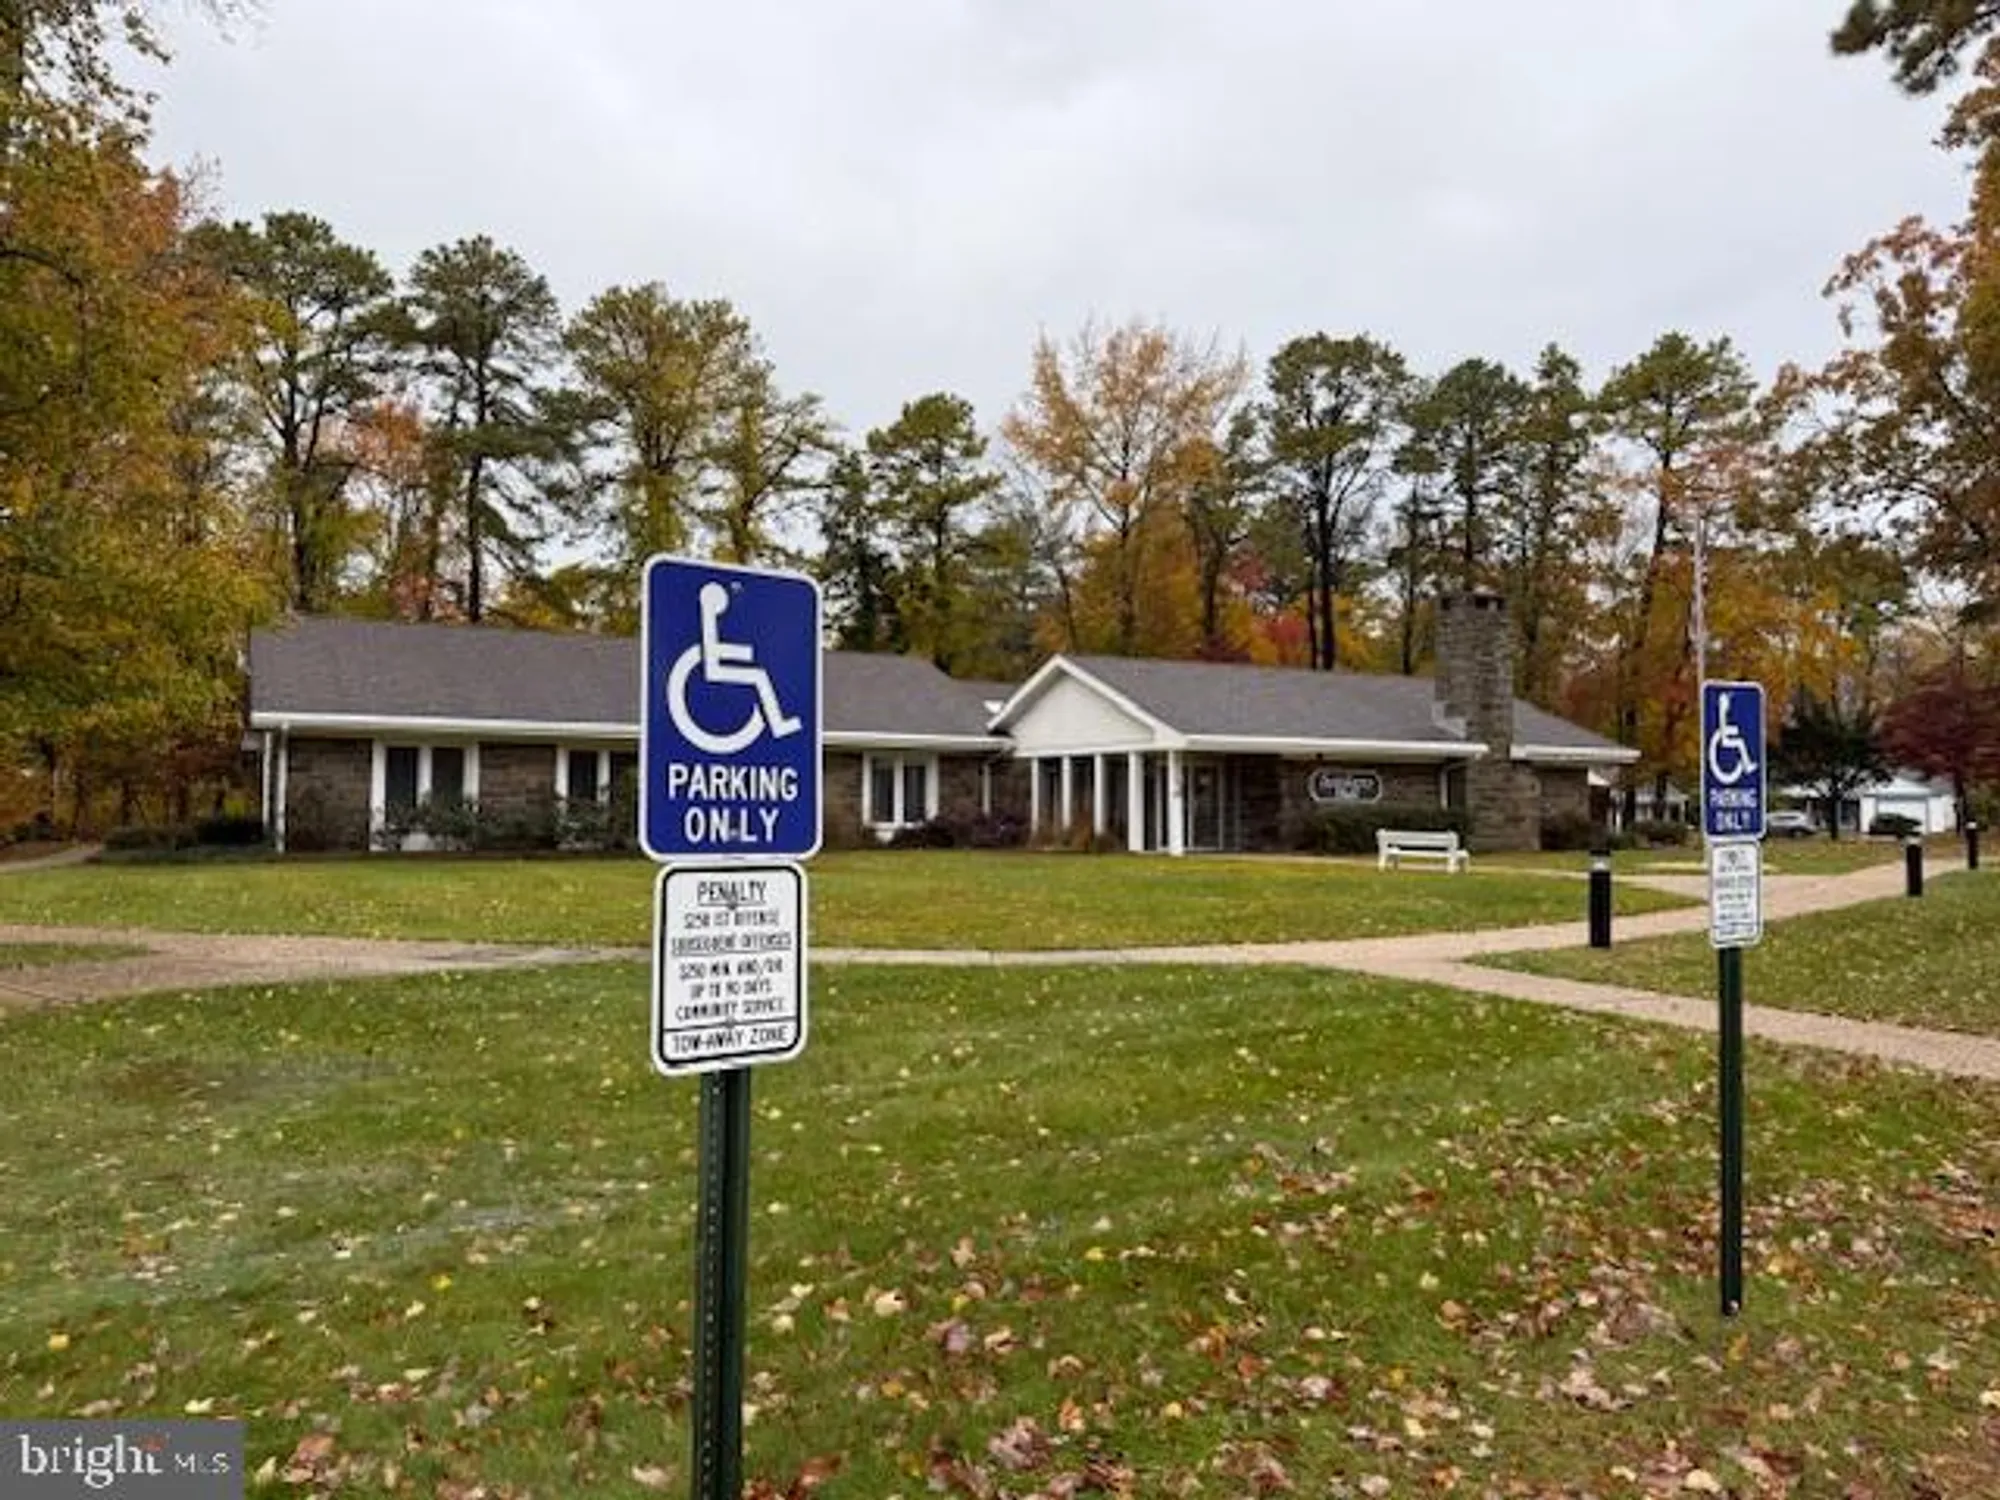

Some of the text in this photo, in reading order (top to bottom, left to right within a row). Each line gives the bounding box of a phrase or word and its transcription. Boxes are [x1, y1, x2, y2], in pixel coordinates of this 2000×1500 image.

[669, 763, 798, 801] PARKING
[1709, 788, 1758, 808] PARKING
[685, 807, 779, 843] ONLY
[697, 881, 767, 902] PENALTY
[734, 909, 780, 927] OFFENSE
[672, 931, 792, 955] SUBSEQUENT OFFENSES
[737, 957, 783, 976] AND/OR
[744, 978, 772, 994] DAYS
[675, 997, 785, 1020] COMMUNITY SERVICE
[673, 1025, 788, 1053] TOW-AWAY ZONE
